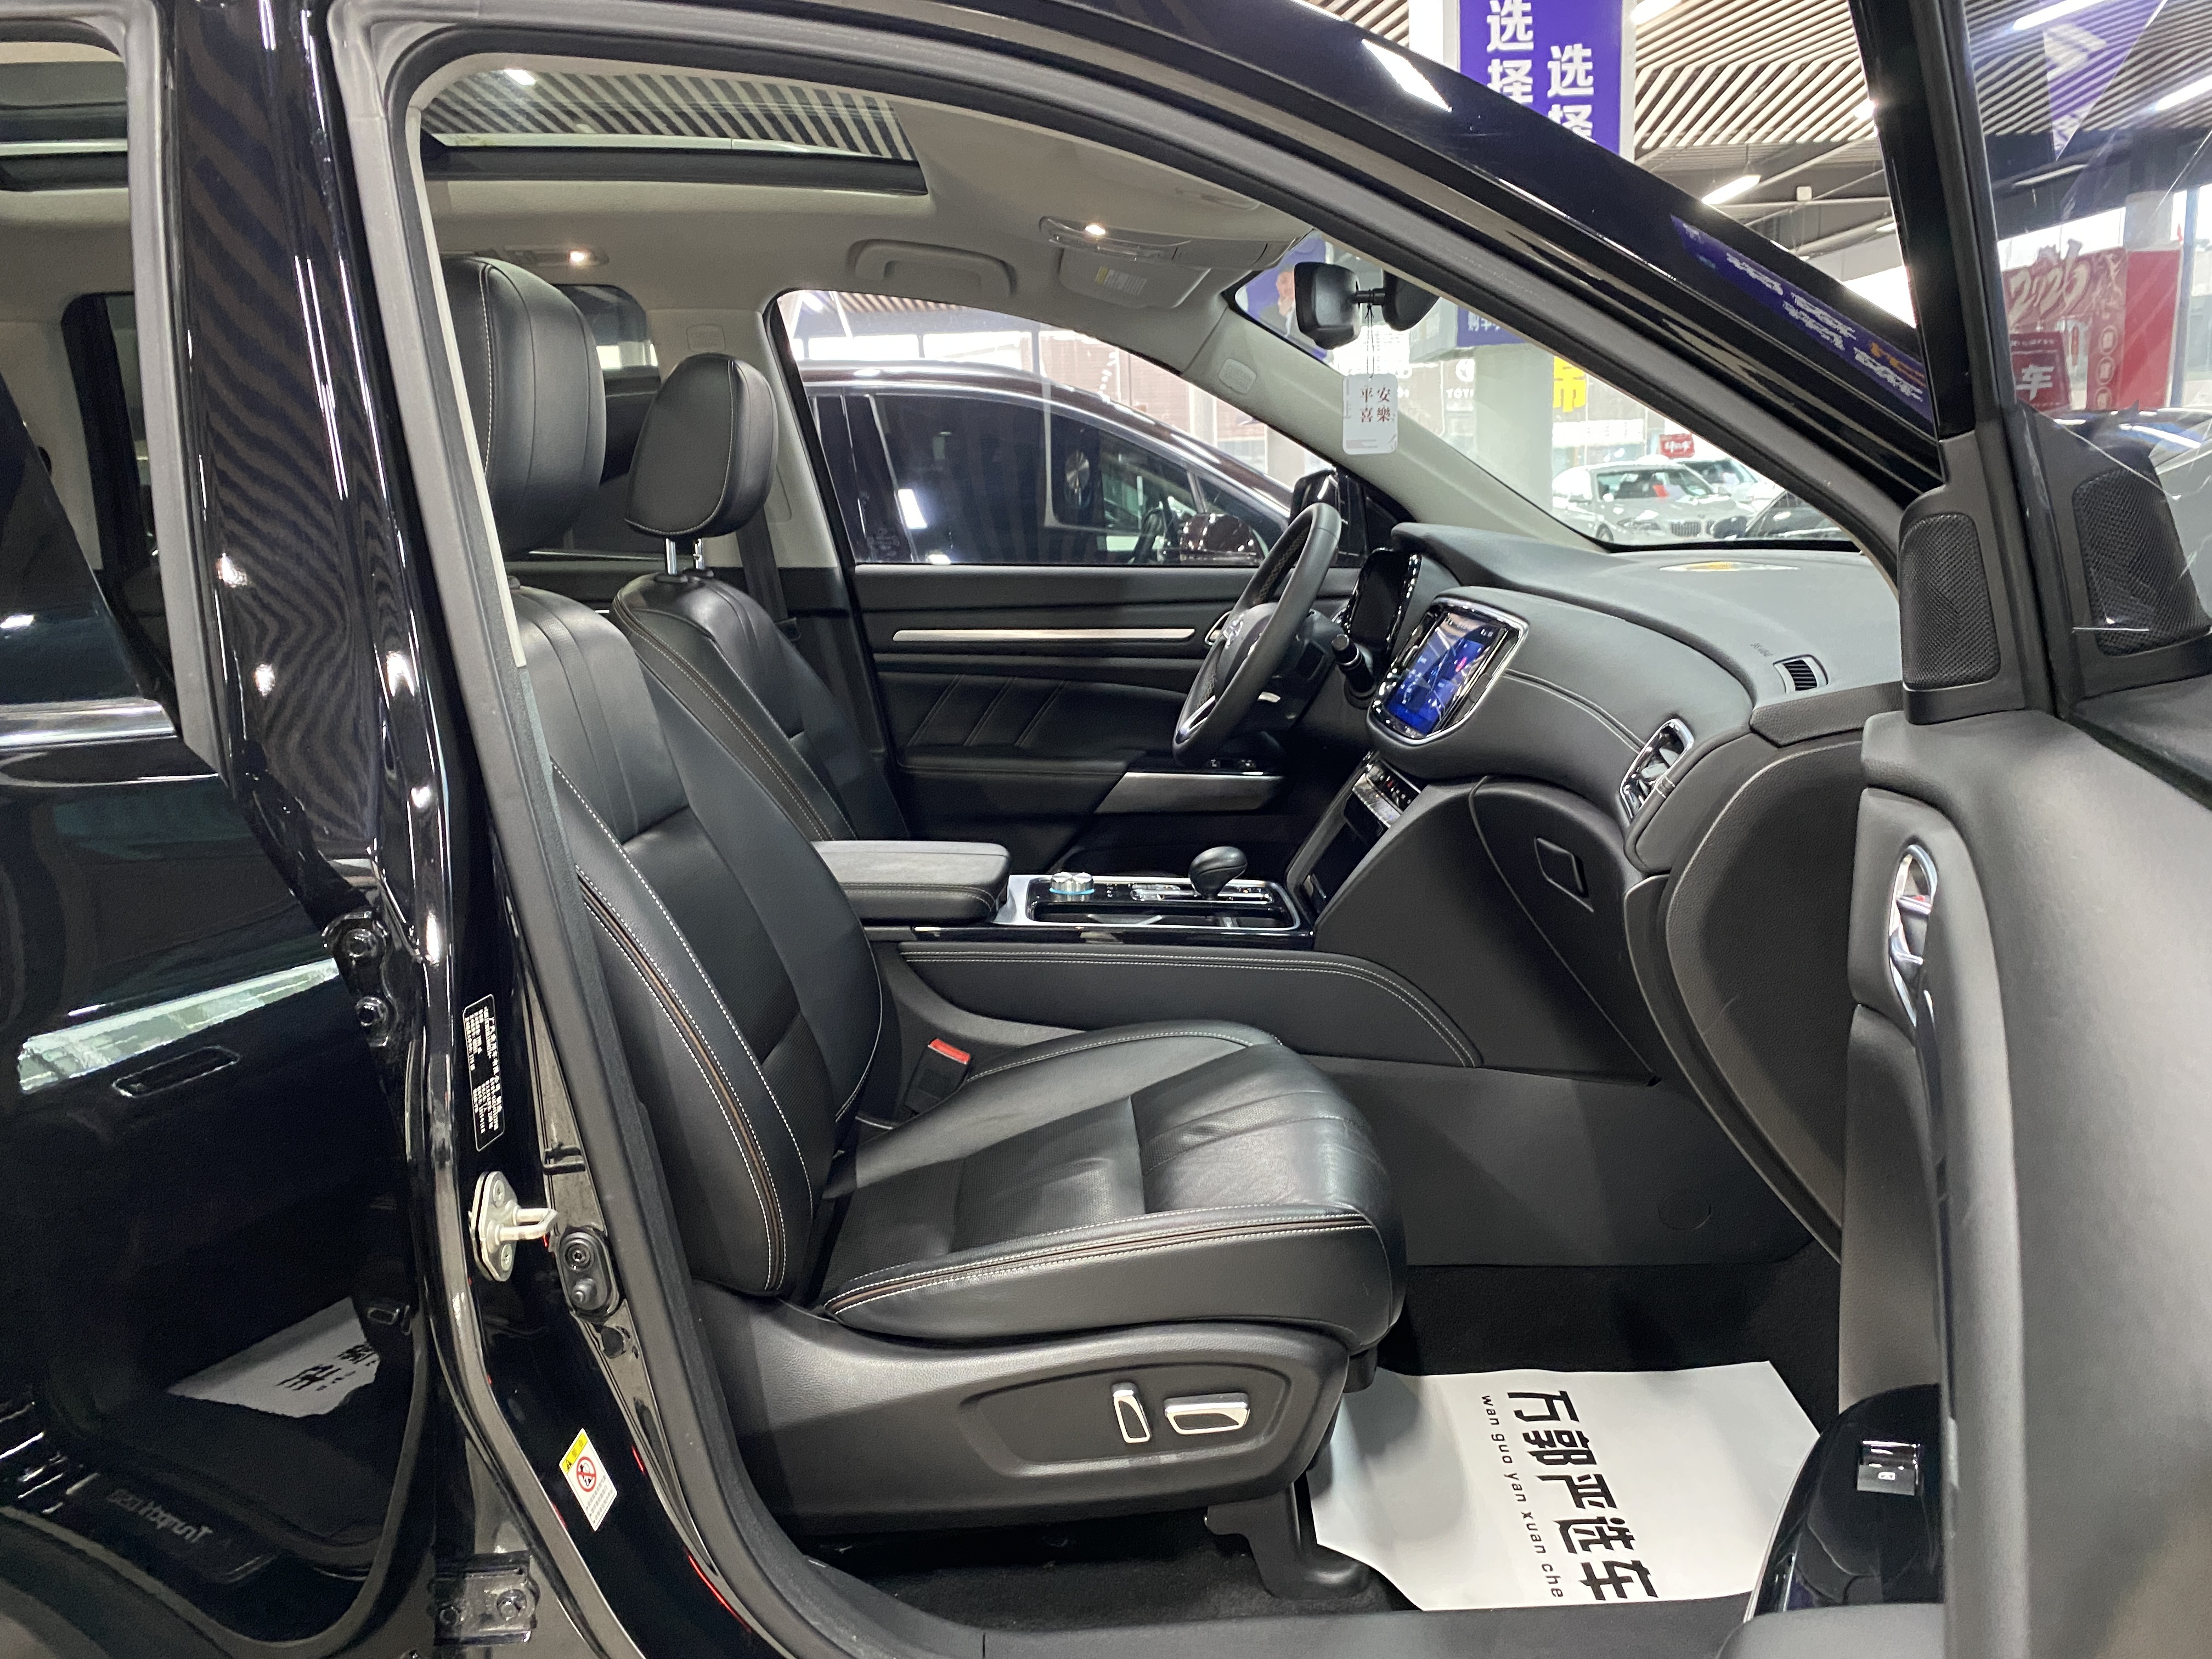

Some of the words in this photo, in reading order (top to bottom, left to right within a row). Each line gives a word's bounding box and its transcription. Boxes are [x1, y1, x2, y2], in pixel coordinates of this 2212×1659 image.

[1487, 0, 1534, 104] 选择
[1360, 385, 1391, 403] 平安
[1481, 1395, 1499, 1426] wan
[1491, 1432, 1513, 1464] guo
[1503, 1472, 1527, 1502] yan
[1520, 1511, 1547, 1554] xuan
[1541, 1562, 1564, 1598] che
